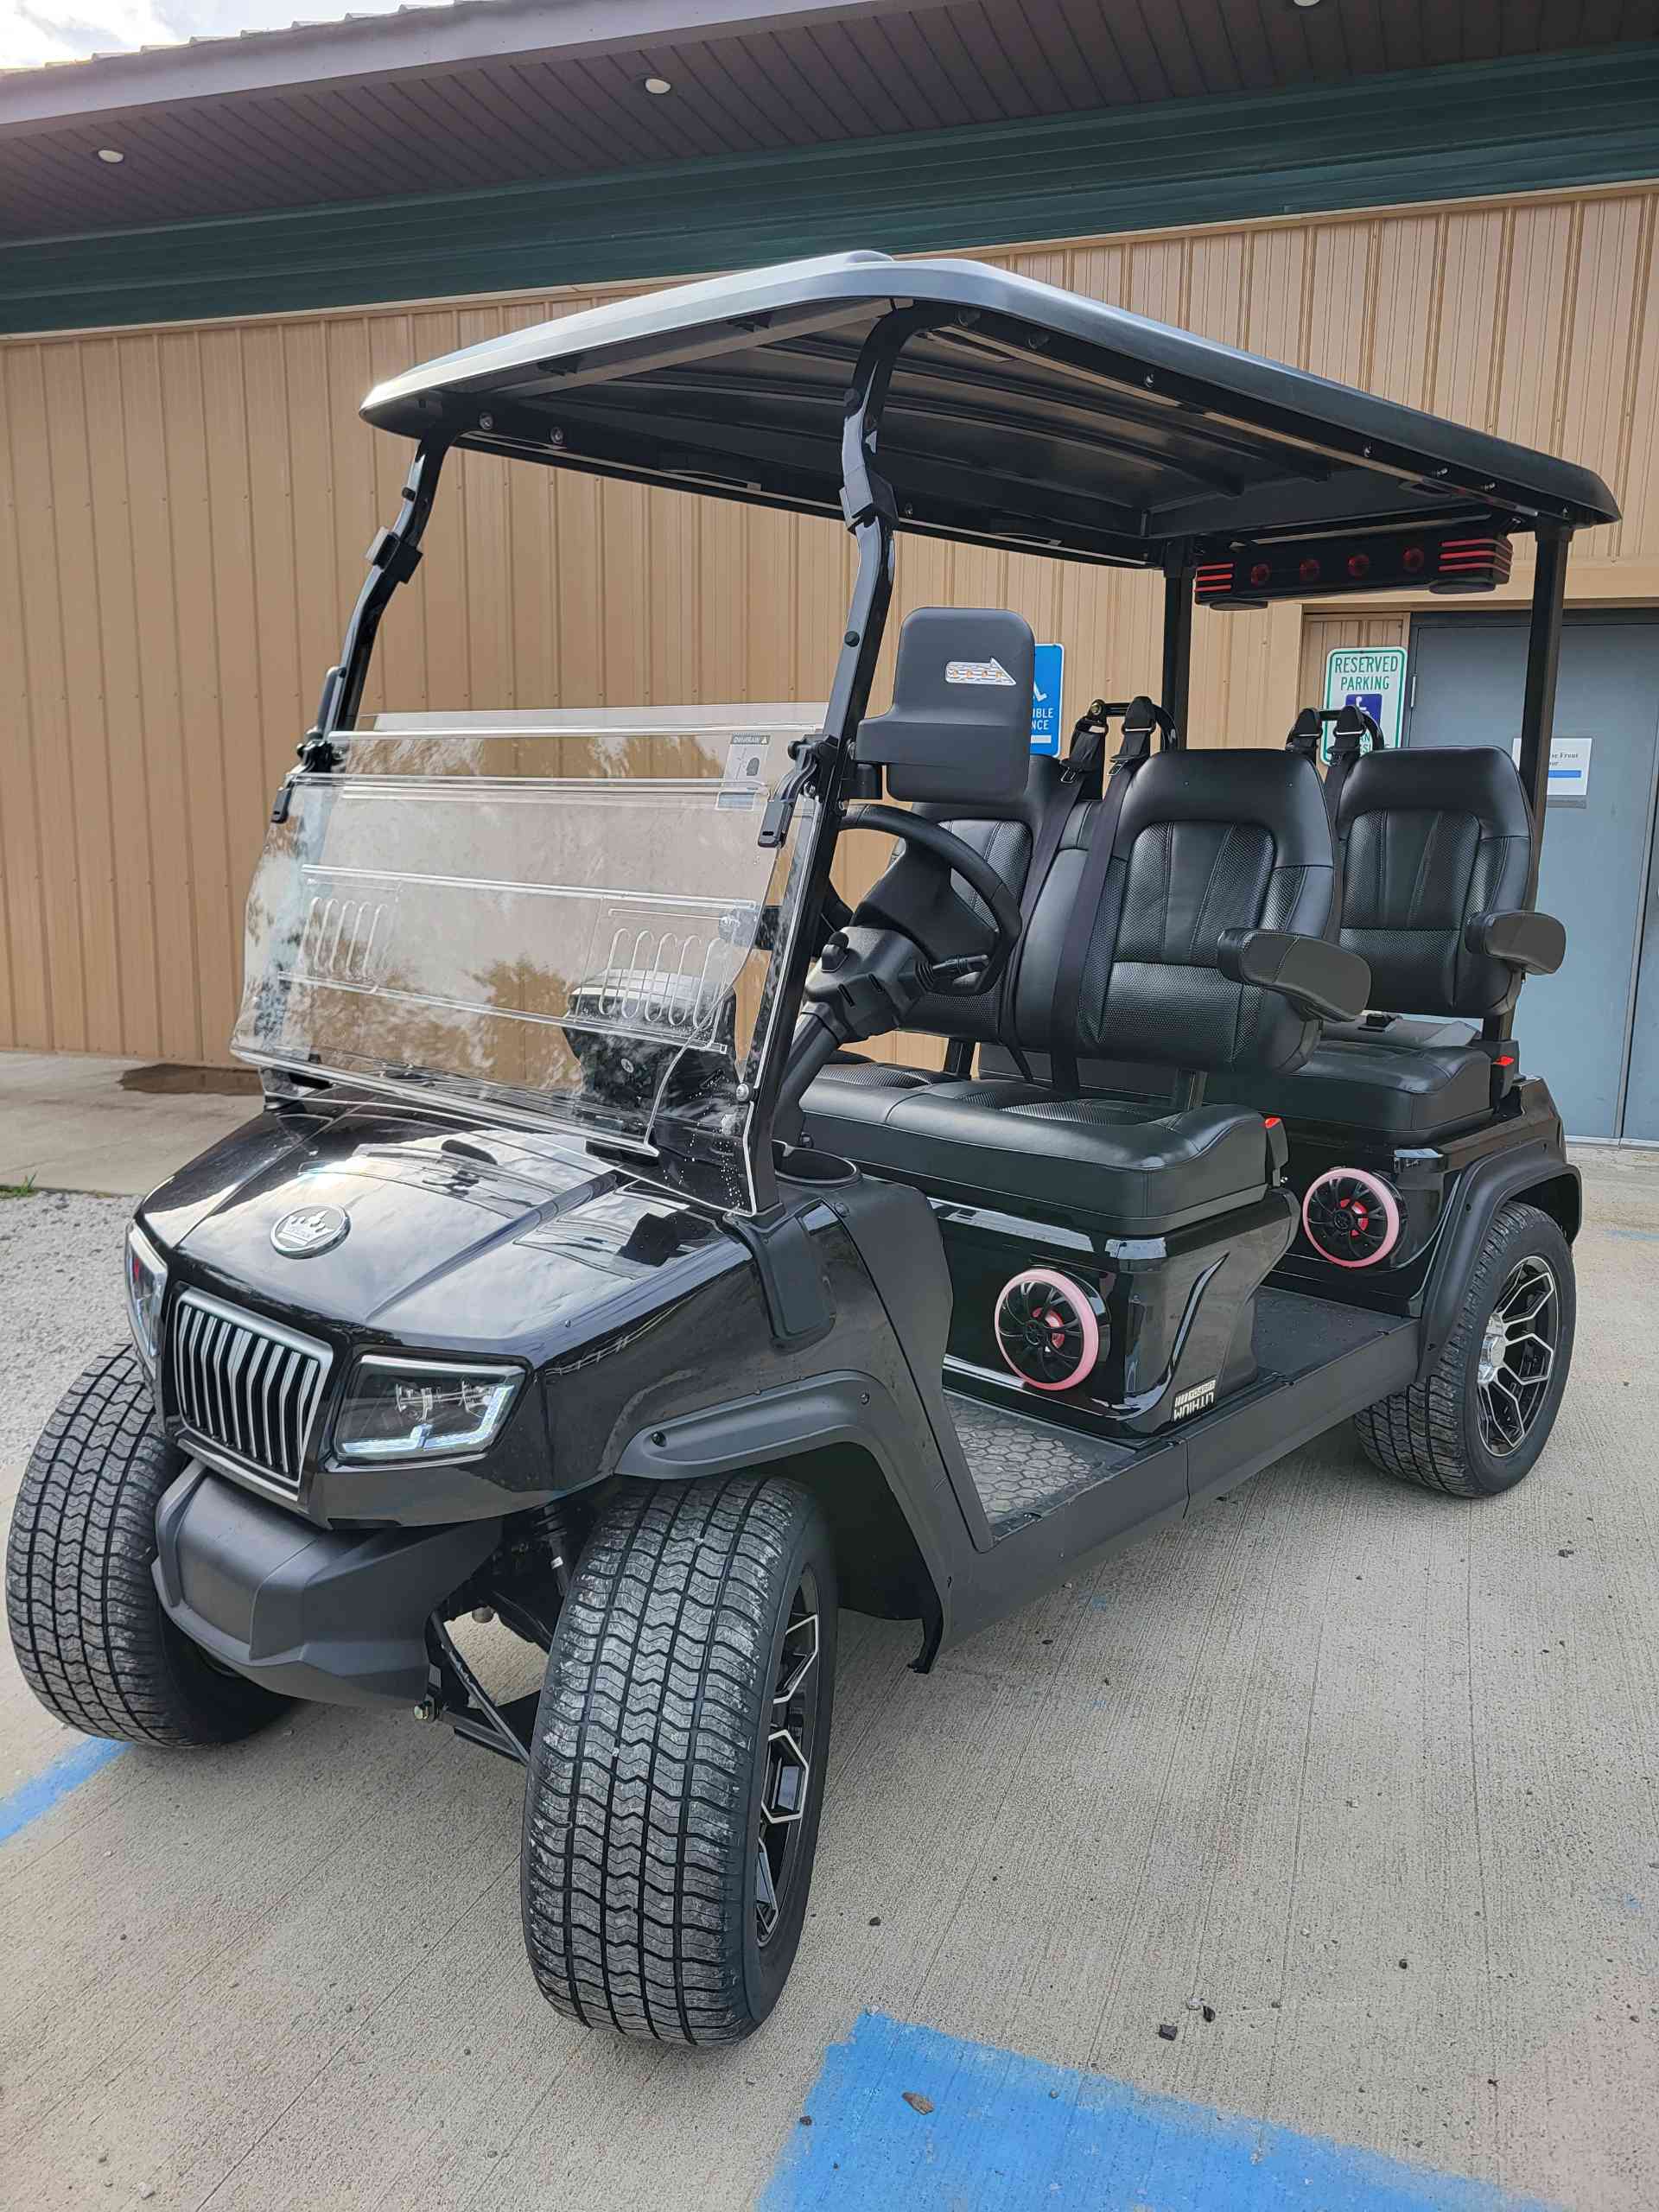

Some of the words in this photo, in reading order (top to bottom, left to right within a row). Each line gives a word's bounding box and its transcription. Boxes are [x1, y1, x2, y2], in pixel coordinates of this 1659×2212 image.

[1335, 657, 1398, 673] RESERVED
[1341, 676, 1390, 690] PARKING
[1174, 1392, 1214, 1421] LITHIUM
